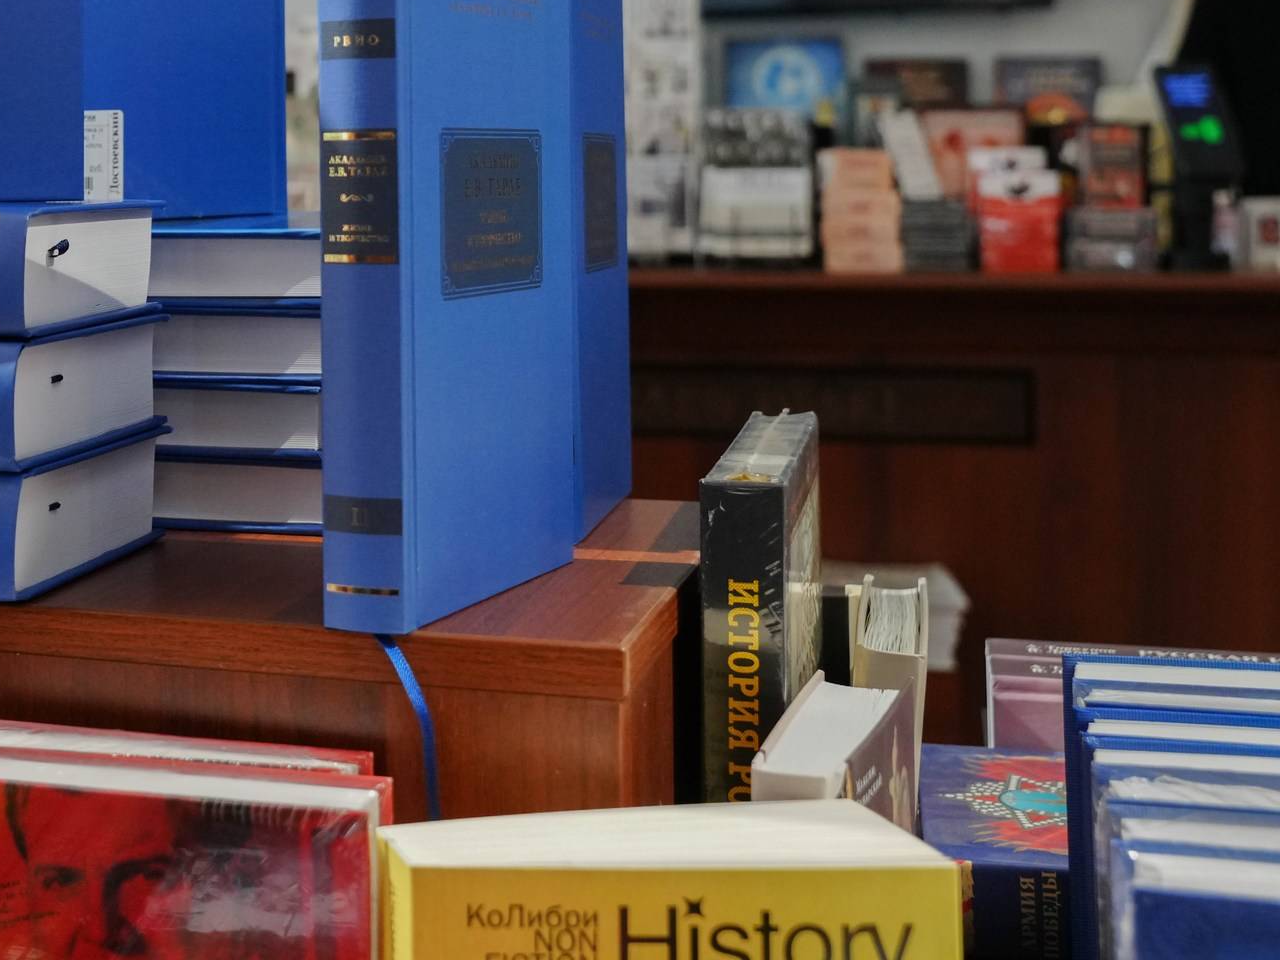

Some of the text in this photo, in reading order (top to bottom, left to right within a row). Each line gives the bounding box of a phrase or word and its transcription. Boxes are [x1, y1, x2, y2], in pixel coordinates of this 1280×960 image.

[333, 34, 380, 47] РВИО
[727, 579, 760, 751] ИСТОРИЯ
[466, 903, 599, 930] КоЛибри
[1020, 877, 1036, 950] АРМИЯ
[1041, 871, 1061, 959] ПОБЕДЫ
[534, 929, 598, 952] NON
